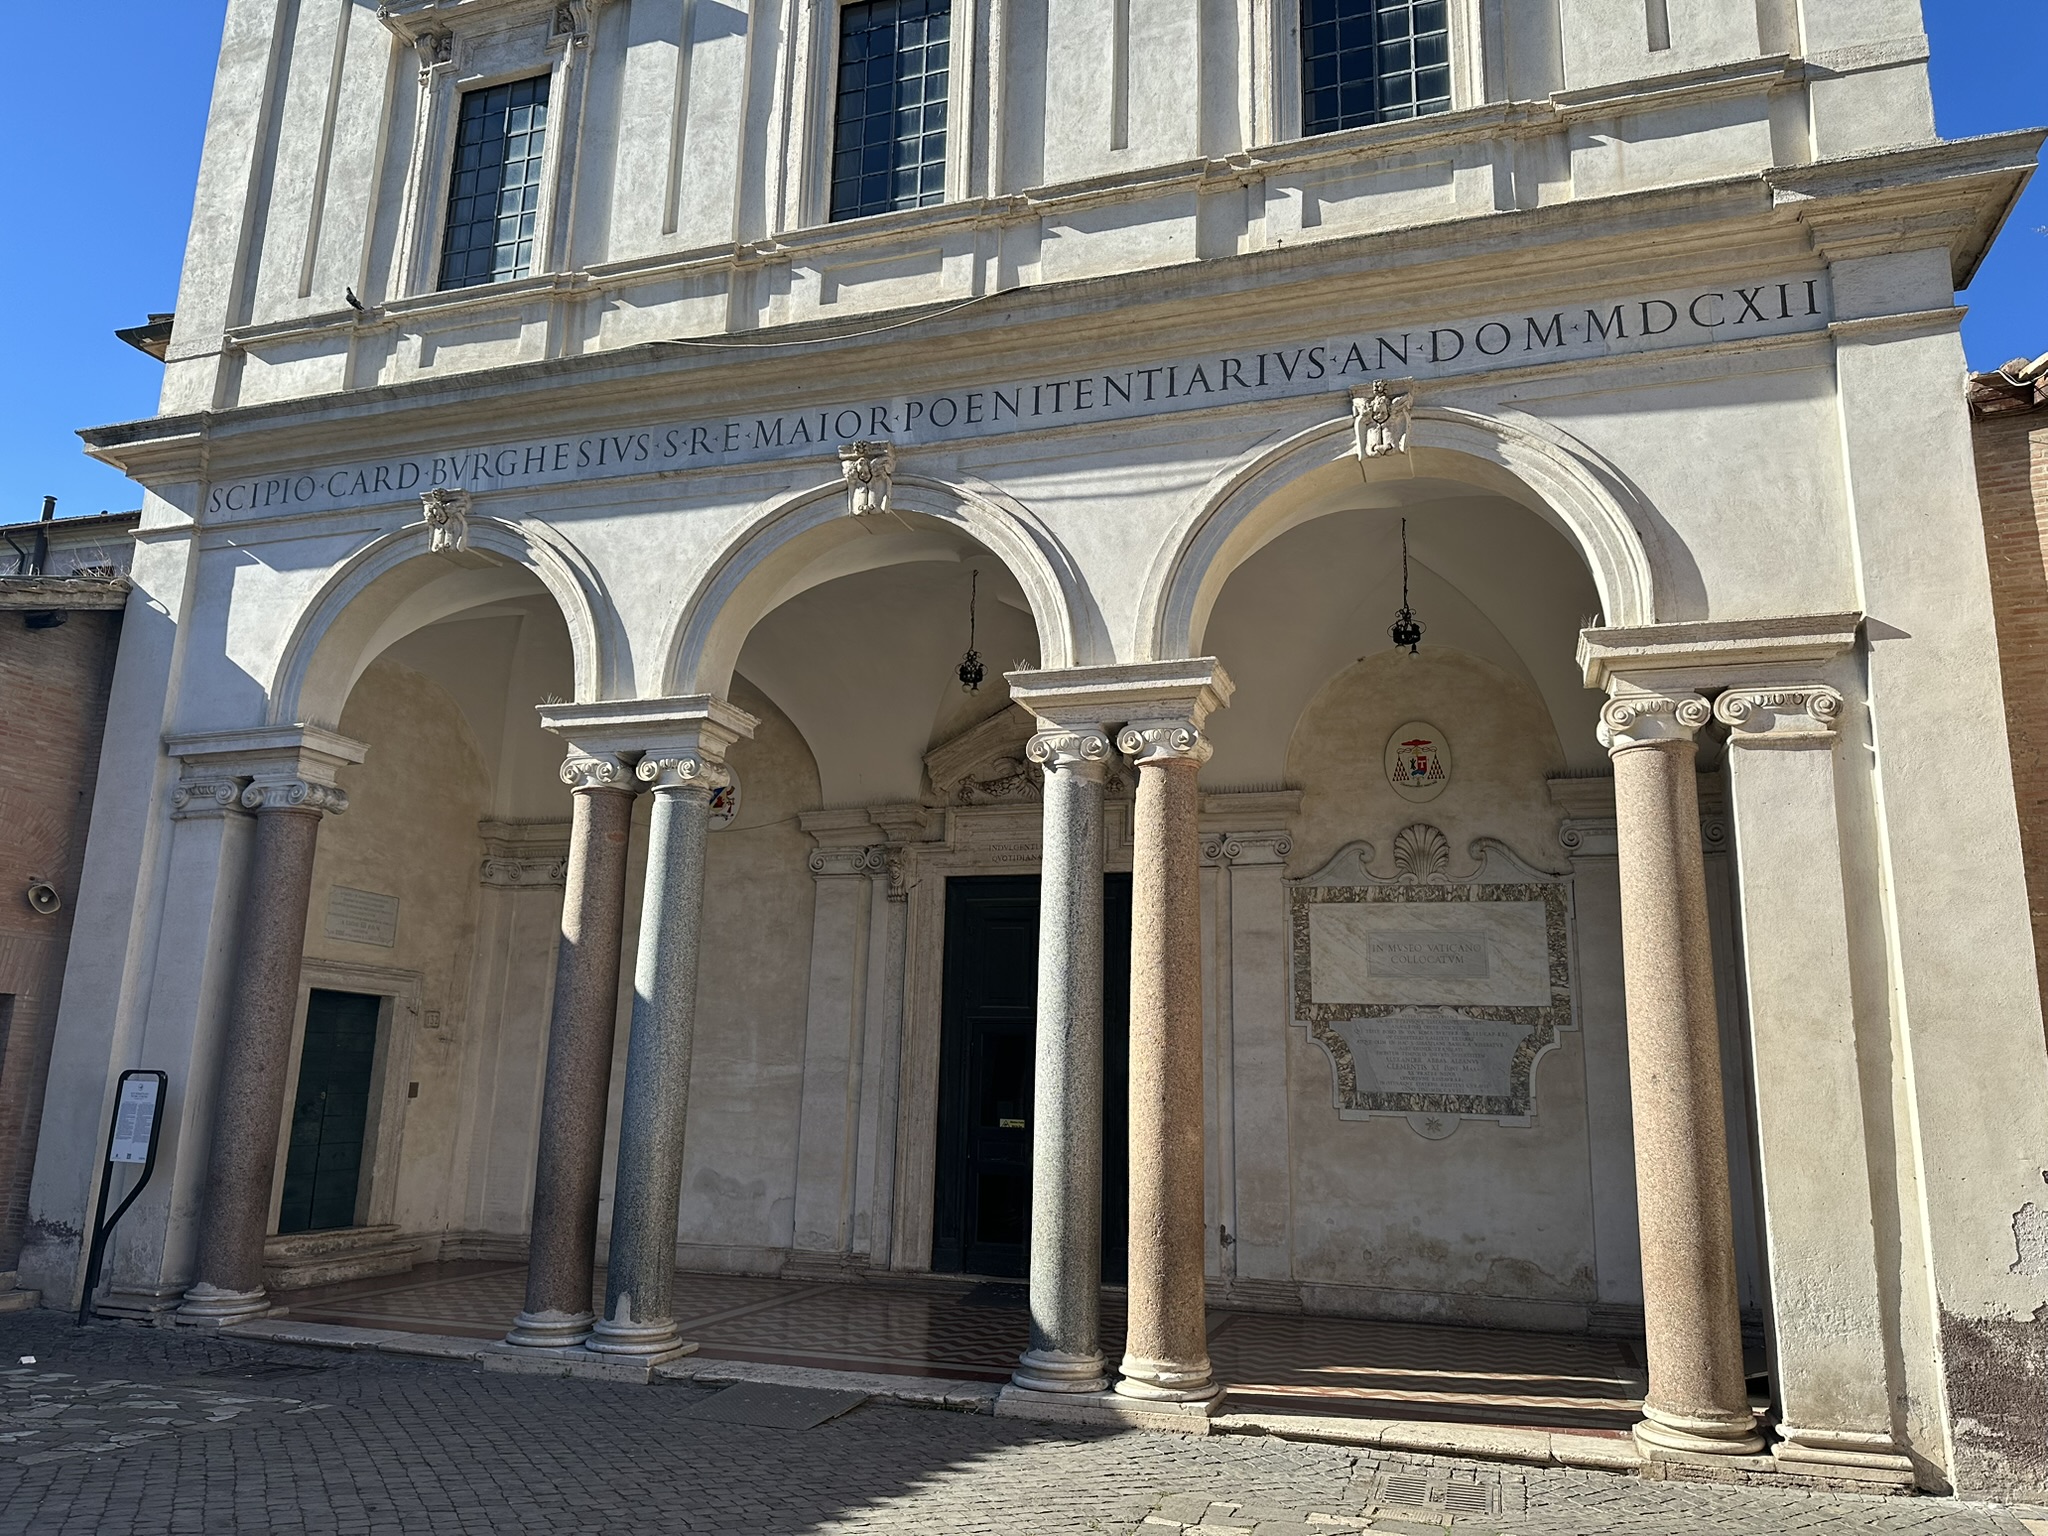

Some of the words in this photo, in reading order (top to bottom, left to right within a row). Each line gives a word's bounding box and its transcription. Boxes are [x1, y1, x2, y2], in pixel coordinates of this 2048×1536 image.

[209, 475, 316, 513] SCIPIO
[327, 461, 419, 497] CARD
[429, 433, 651, 486] BVRGHESIVS
[752, 406, 896, 450] MAIOR
[903, 346, 1326, 432] POENITENTIARIVS
[1338, 333, 1411, 375] AN
[1428, 312, 1566, 364] DOM
[1583, 279, 1822, 344] MDCXII
[988, 842, 1043, 851] INDVLGENTI
[1372, 944, 1384, 953] IN
[1388, 944, 1422, 953] MVSEO
[1428, 943, 1481, 953] VATICANO
[1390, 955, 1464, 964] COLLOCATVM
